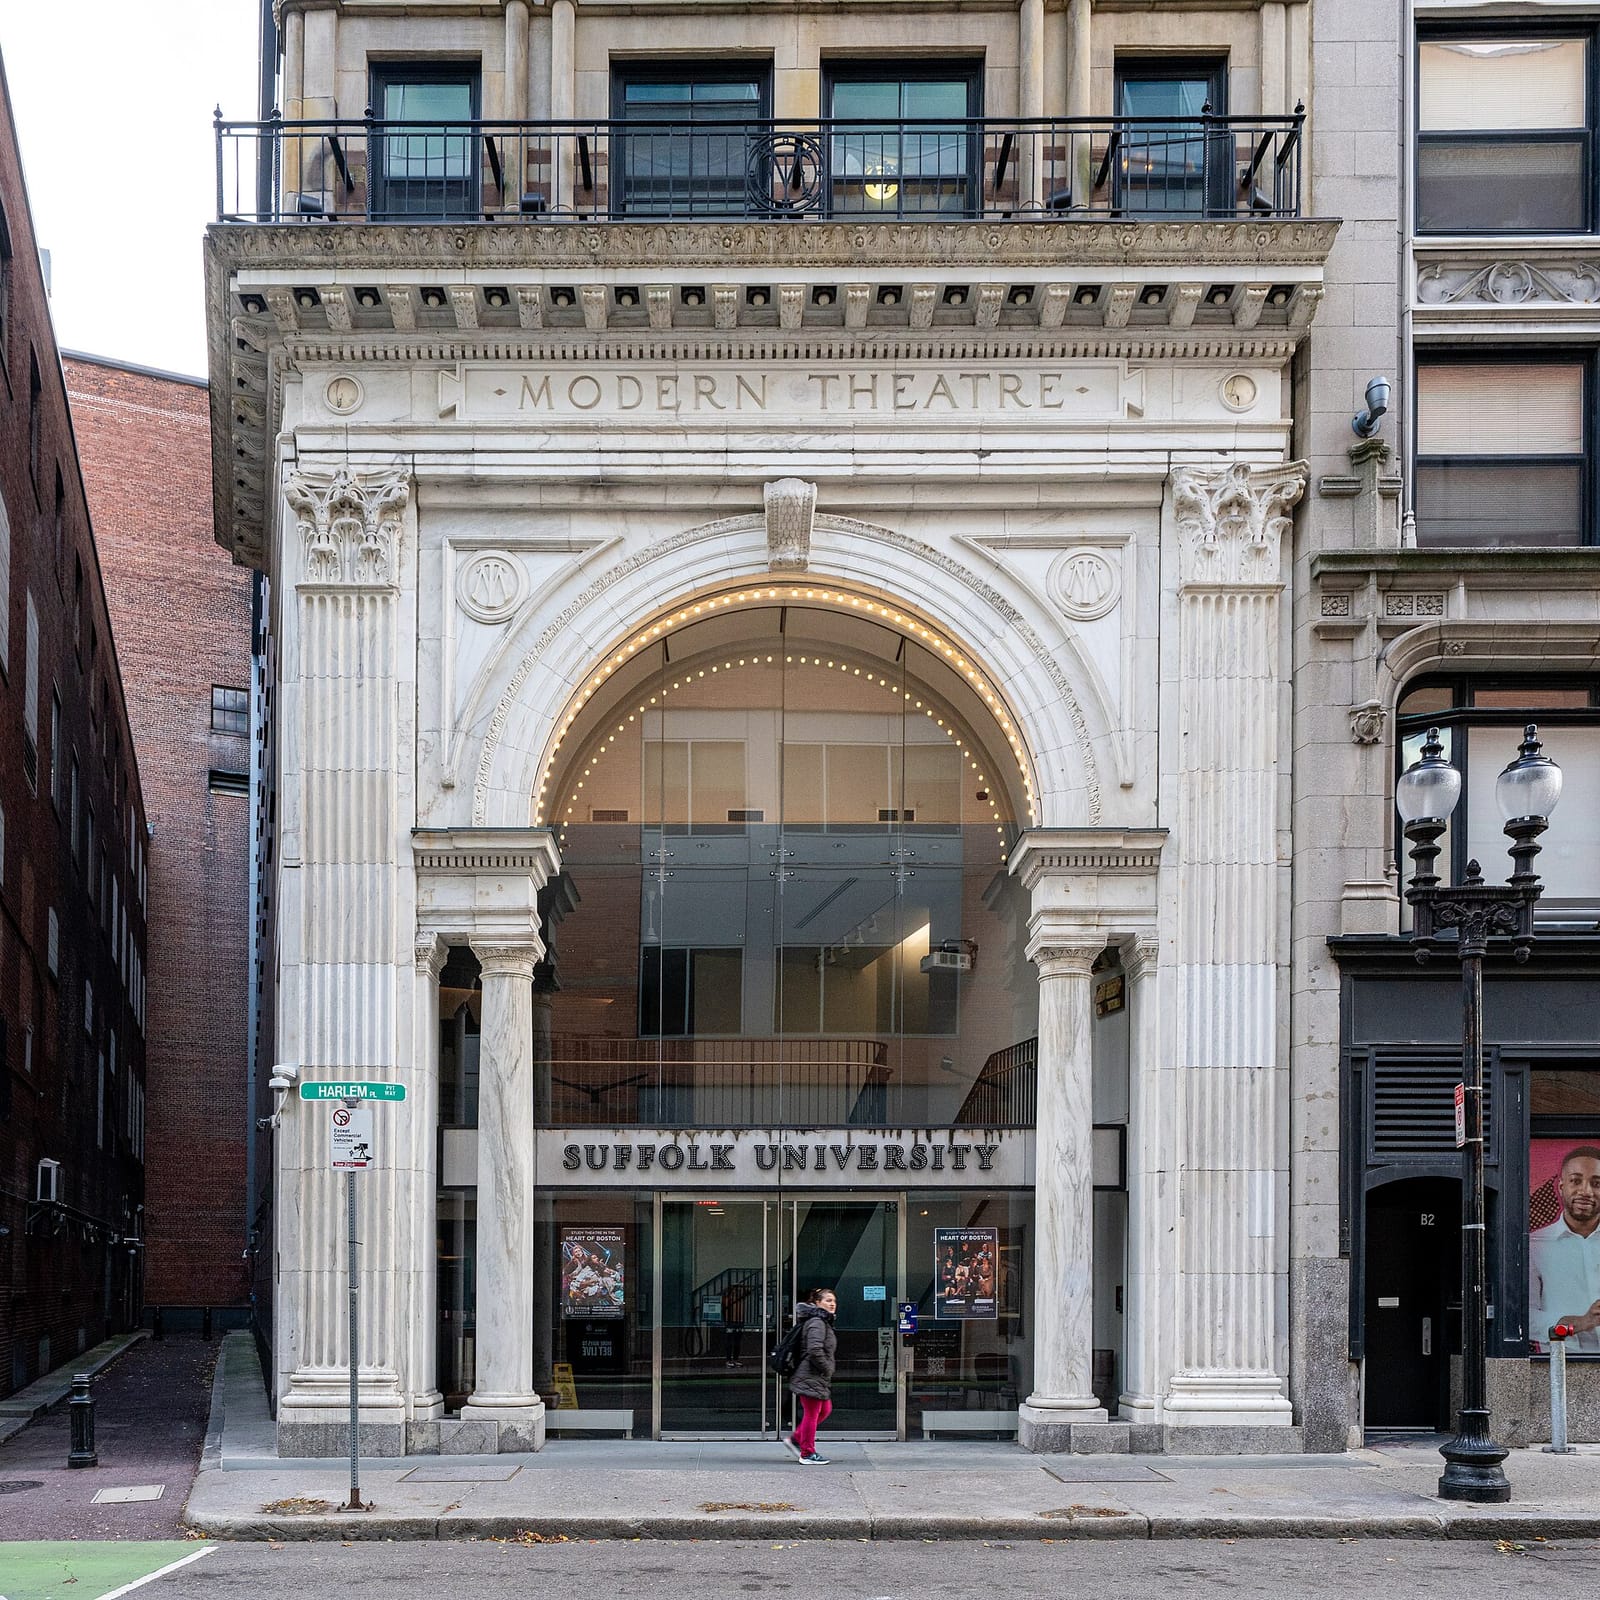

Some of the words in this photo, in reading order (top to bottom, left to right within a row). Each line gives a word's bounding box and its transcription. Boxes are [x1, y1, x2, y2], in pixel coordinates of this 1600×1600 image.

[517, 375, 767, 410] MODERN
[808, 373, 1064, 409] THEATRE
[318, 1085, 368, 1098] HARLEM
[562, 1143, 736, 1171] SUFFOLK
[754, 1143, 1000, 1171] UNIVERSITY
[1421, 1213, 1435, 1225] B2
